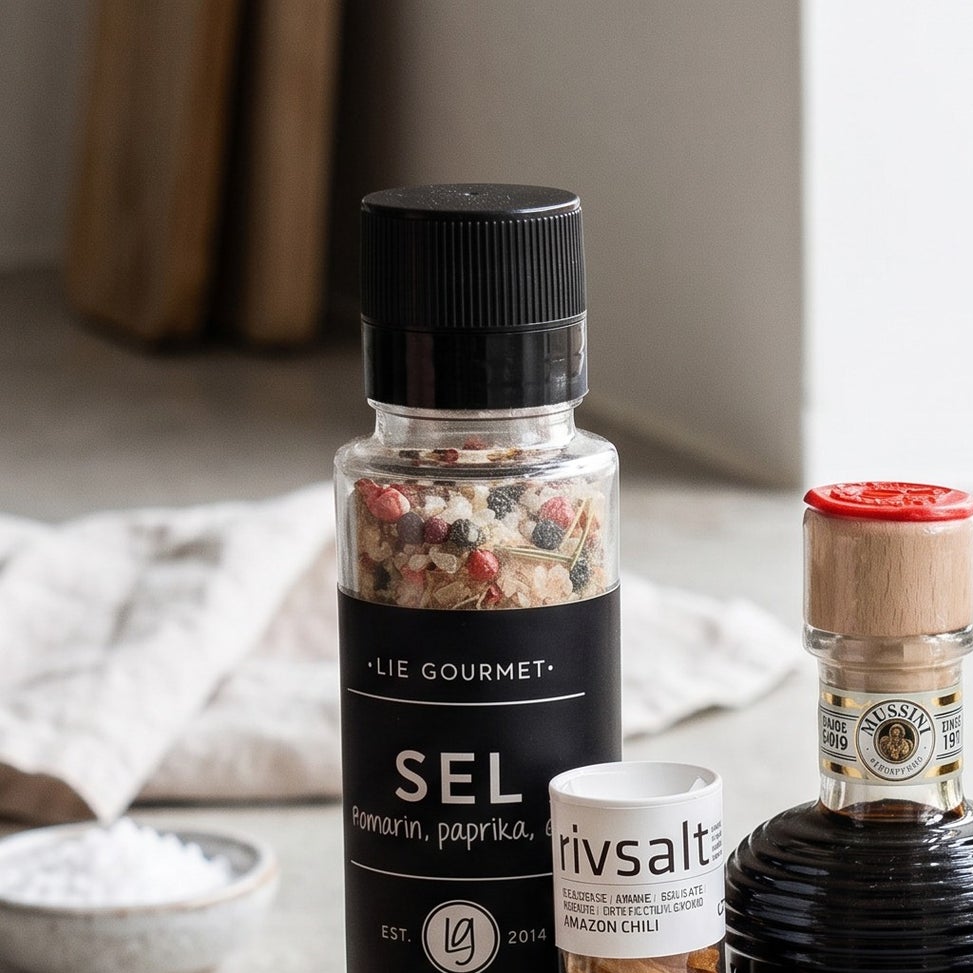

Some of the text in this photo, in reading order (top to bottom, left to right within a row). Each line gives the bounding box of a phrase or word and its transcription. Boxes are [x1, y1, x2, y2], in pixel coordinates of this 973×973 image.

[860, 703, 932, 738] MUSSINI
[395, 749, 523, 805] SEL
[437, 817, 535, 851] paprika,
[559, 820, 710, 877] rivsalt
[381, 924, 412, 943] EST.
[507, 928, 547, 945] 2014
[563, 914, 660, 934] AMAZON CHILI
